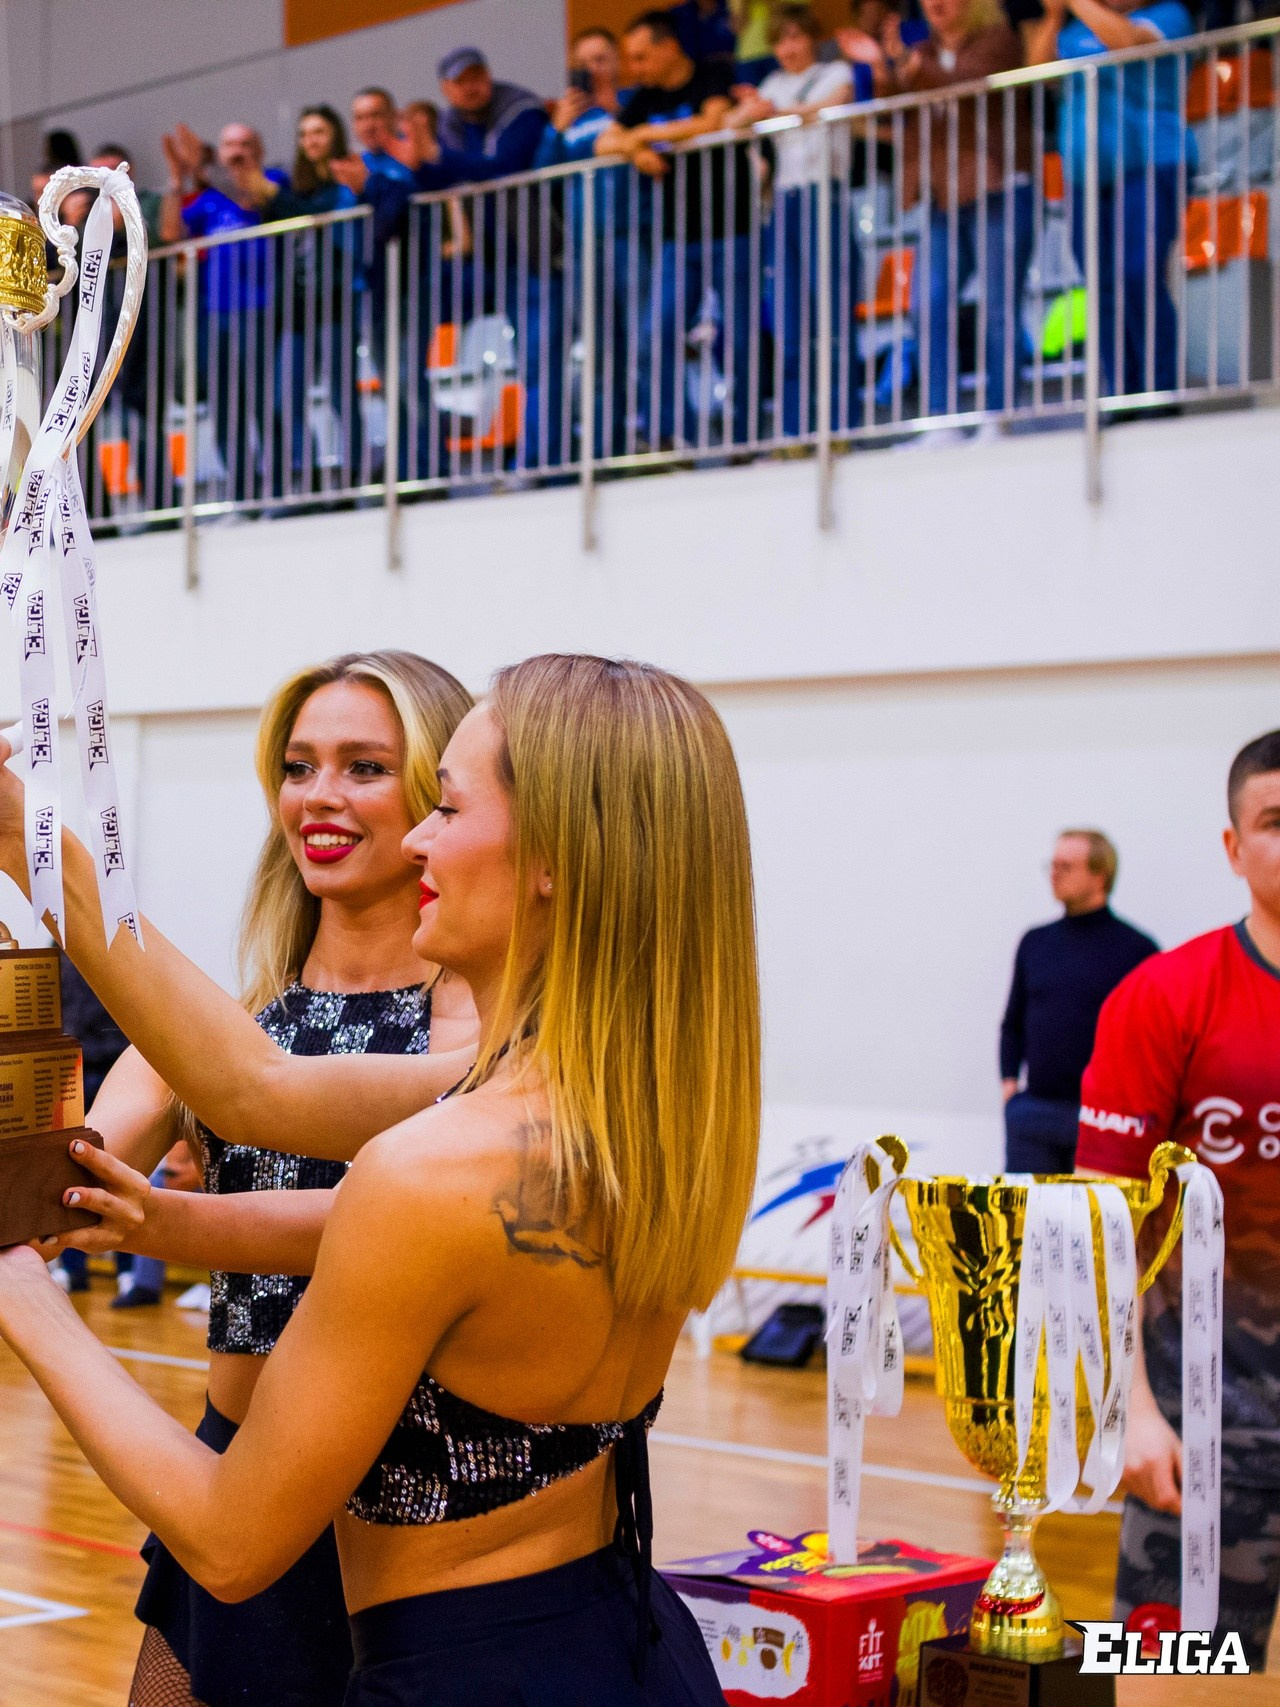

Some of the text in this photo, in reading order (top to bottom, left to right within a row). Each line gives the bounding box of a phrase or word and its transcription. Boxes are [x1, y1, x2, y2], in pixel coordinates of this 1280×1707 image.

[81, 248, 103, 312] ELIGA
[45, 375, 80, 434] ELIGA
[14, 470, 45, 534] ELIGA
[28, 488, 51, 557] ELIGA
[25, 590, 46, 661] ELIGA
[73, 592, 98, 664] ELIGA
[31, 698, 53, 770] ELIGA
[87, 700, 109, 772] ELIGA
[33, 806, 54, 877] ELIGA
[100, 806, 125, 878] ELIGA
